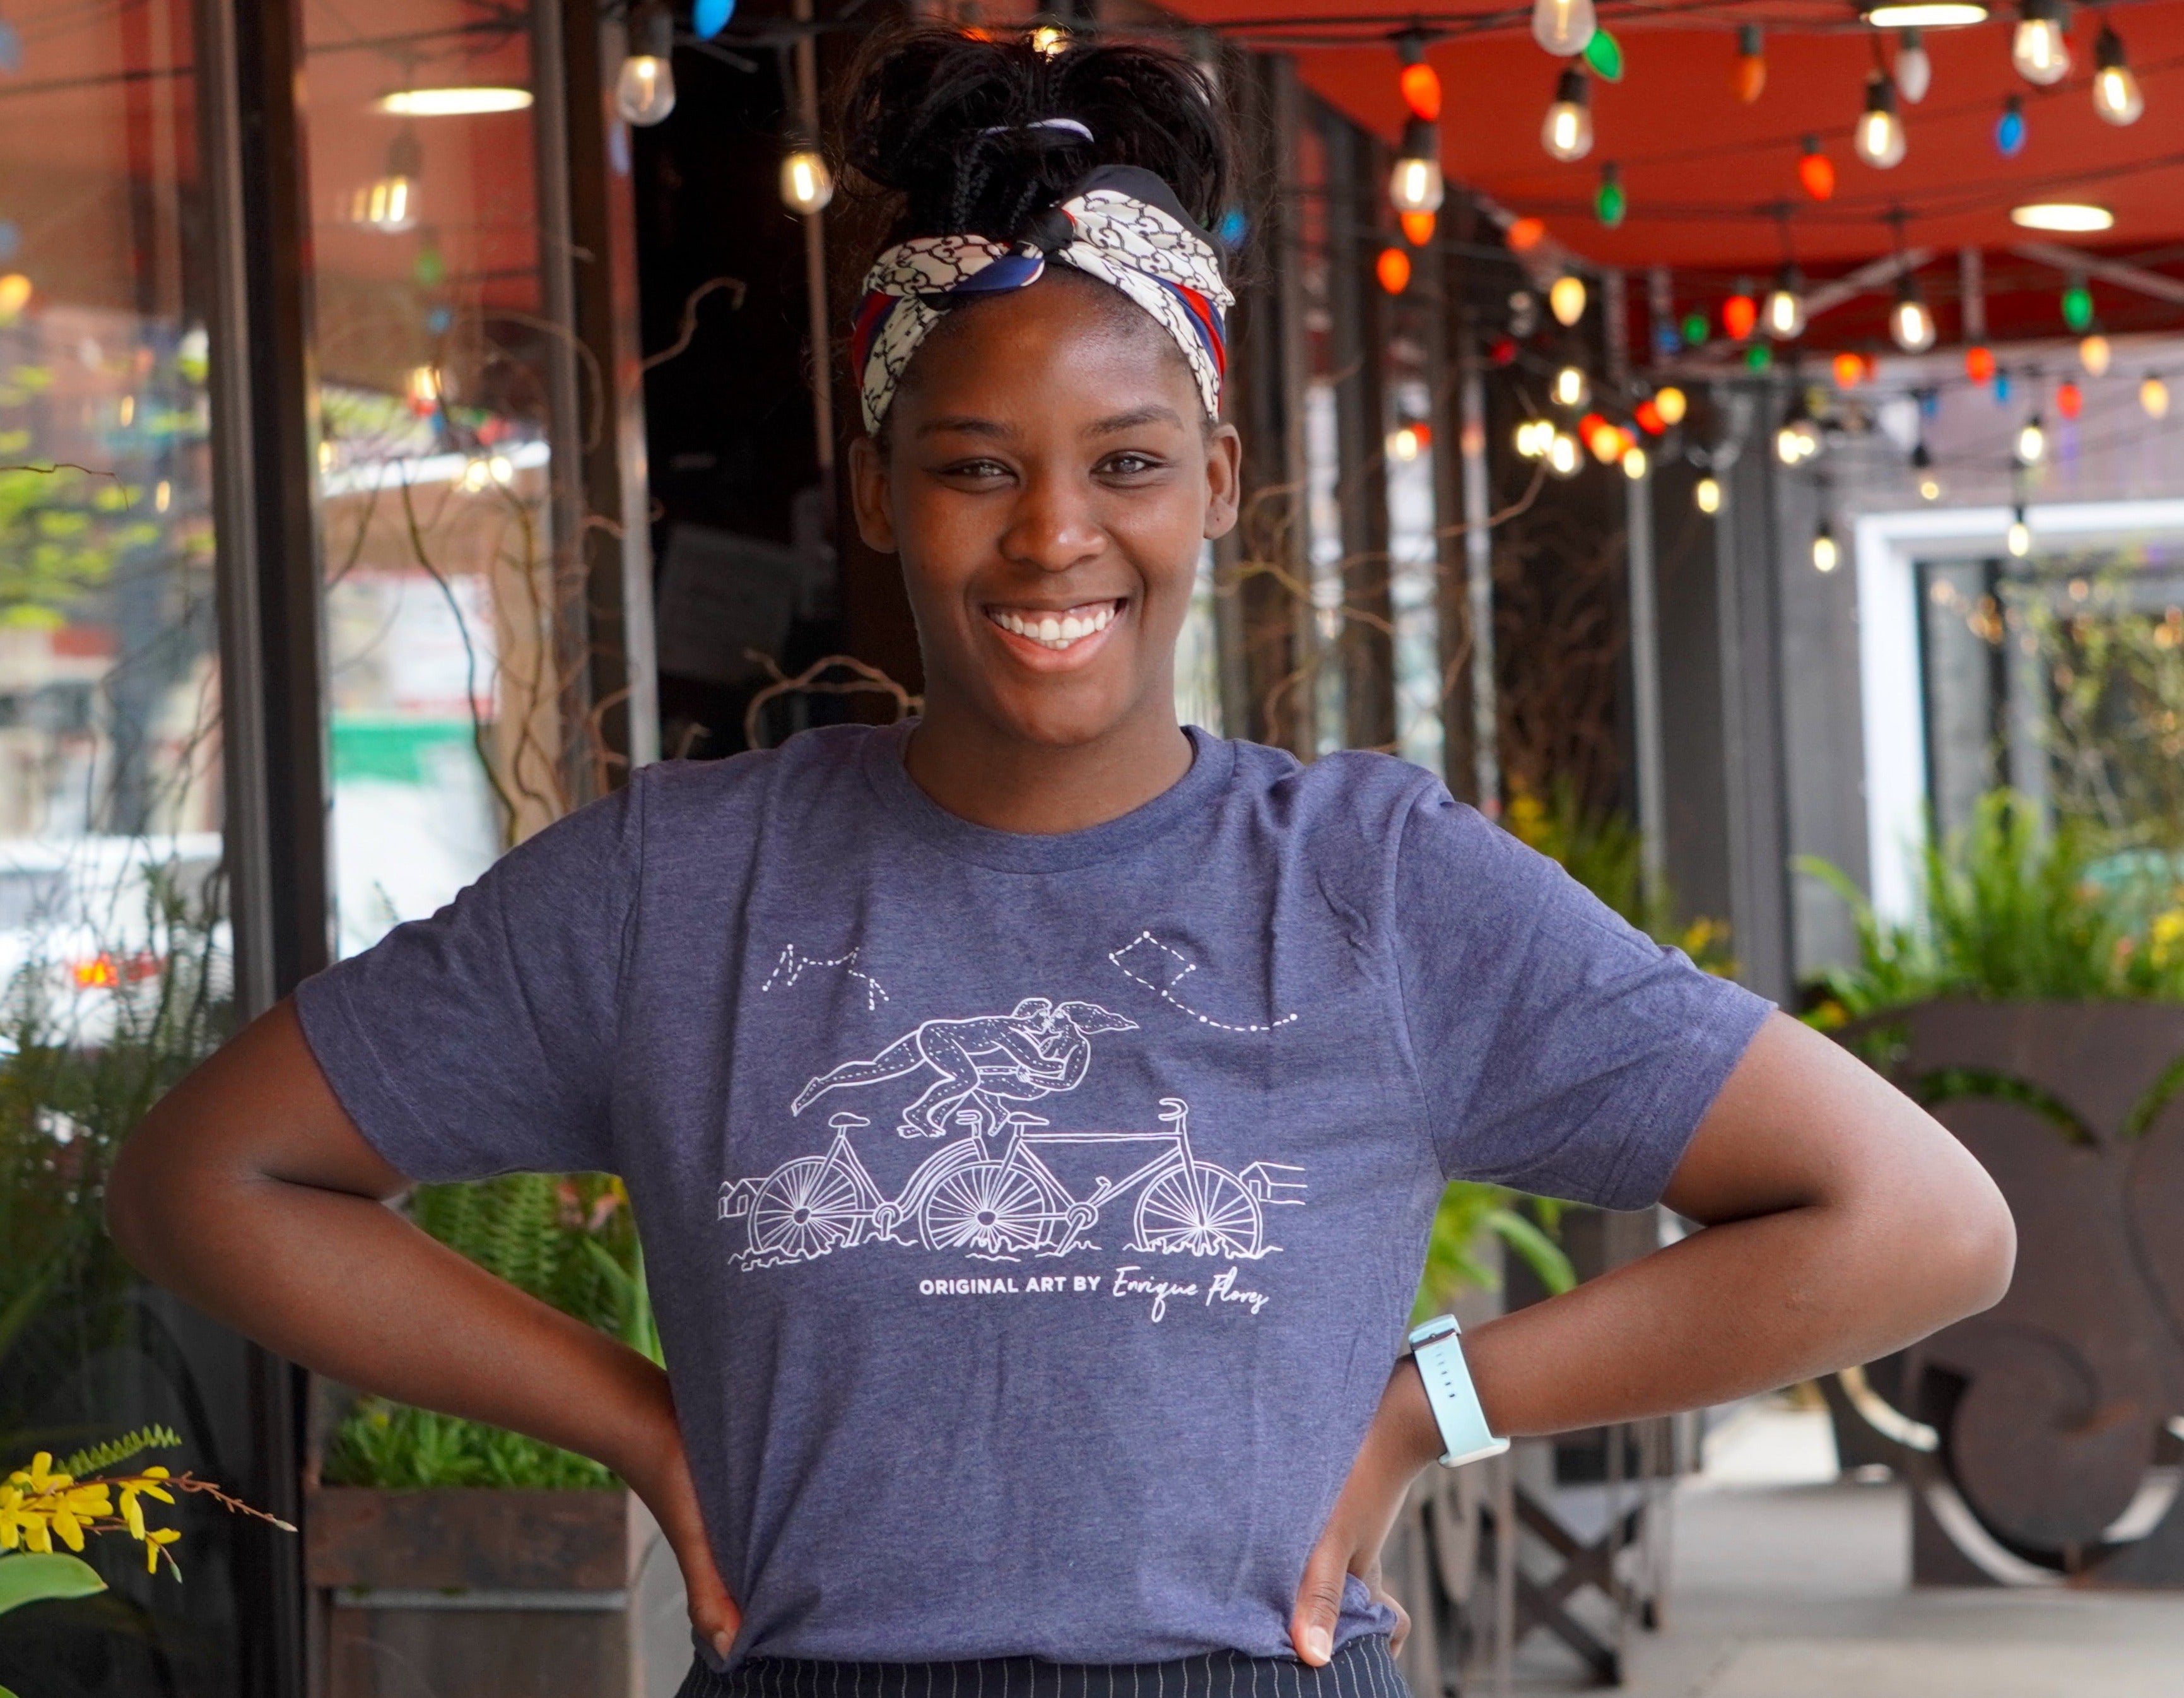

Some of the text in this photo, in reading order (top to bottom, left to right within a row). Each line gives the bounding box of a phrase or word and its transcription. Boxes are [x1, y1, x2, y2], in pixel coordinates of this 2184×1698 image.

[919, 1278, 1019, 1295] ORIGINAL
[1025, 1276, 1067, 1293] ART
[1074, 1276, 1101, 1292] BY
[1112, 1266, 1199, 1323] Enrique
